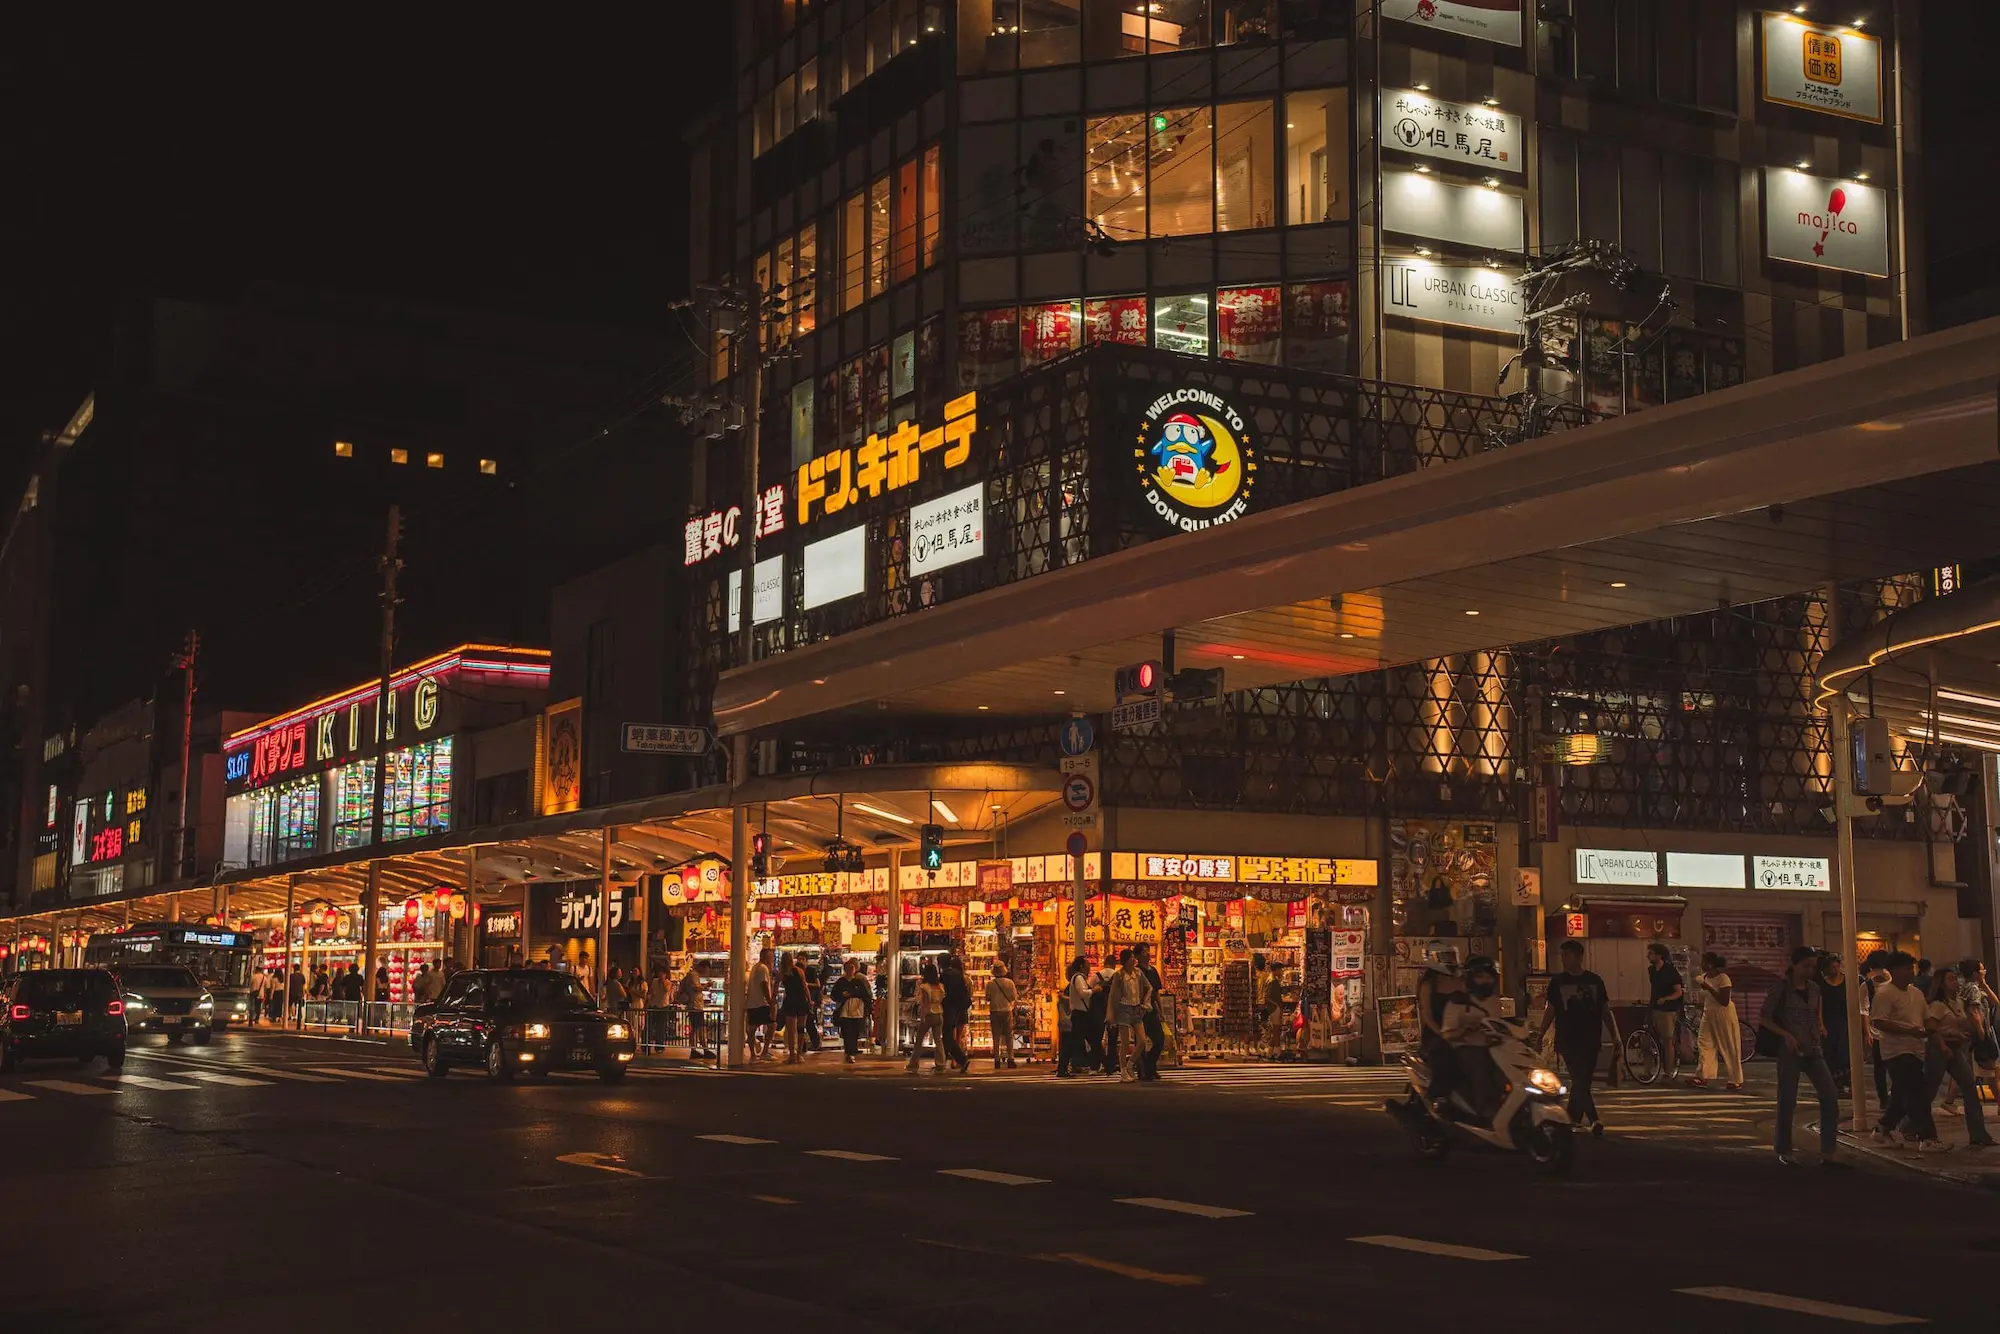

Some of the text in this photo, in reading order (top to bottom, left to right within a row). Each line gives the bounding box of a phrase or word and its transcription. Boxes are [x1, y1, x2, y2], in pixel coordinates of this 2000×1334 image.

[1808, 58, 1837, 79] 価格
[1396, 99, 1506, 133] 牛しゃぶ 牛すき 食べ放題
[1426, 127, 1497, 161] 但馬屋
[1424, 277, 1466, 296] URBAN
[1470, 284, 1518, 305] CLASSIC
[1448, 300, 1495, 315] PILATES
[1145, 388, 1244, 431] WELCOME TO
[1145, 489, 1179, 525] DON
[931, 524, 974, 554] 但馬屋
[317, 676, 438, 761] KING
[253, 724, 306, 779] パチンコ
[227, 752, 249, 780] SLOT
[92, 828, 122, 861] スギ薬局
[1147, 857, 1232, 878] 驚安の殿堂
[1599, 858, 1624, 869] URBAN
[1625, 859, 1654, 870] CLASSIC
[1778, 873, 1817, 887] 但馬屋
[1115, 908, 1157, 930] 免税
[1134, 931, 1155, 941] Free
